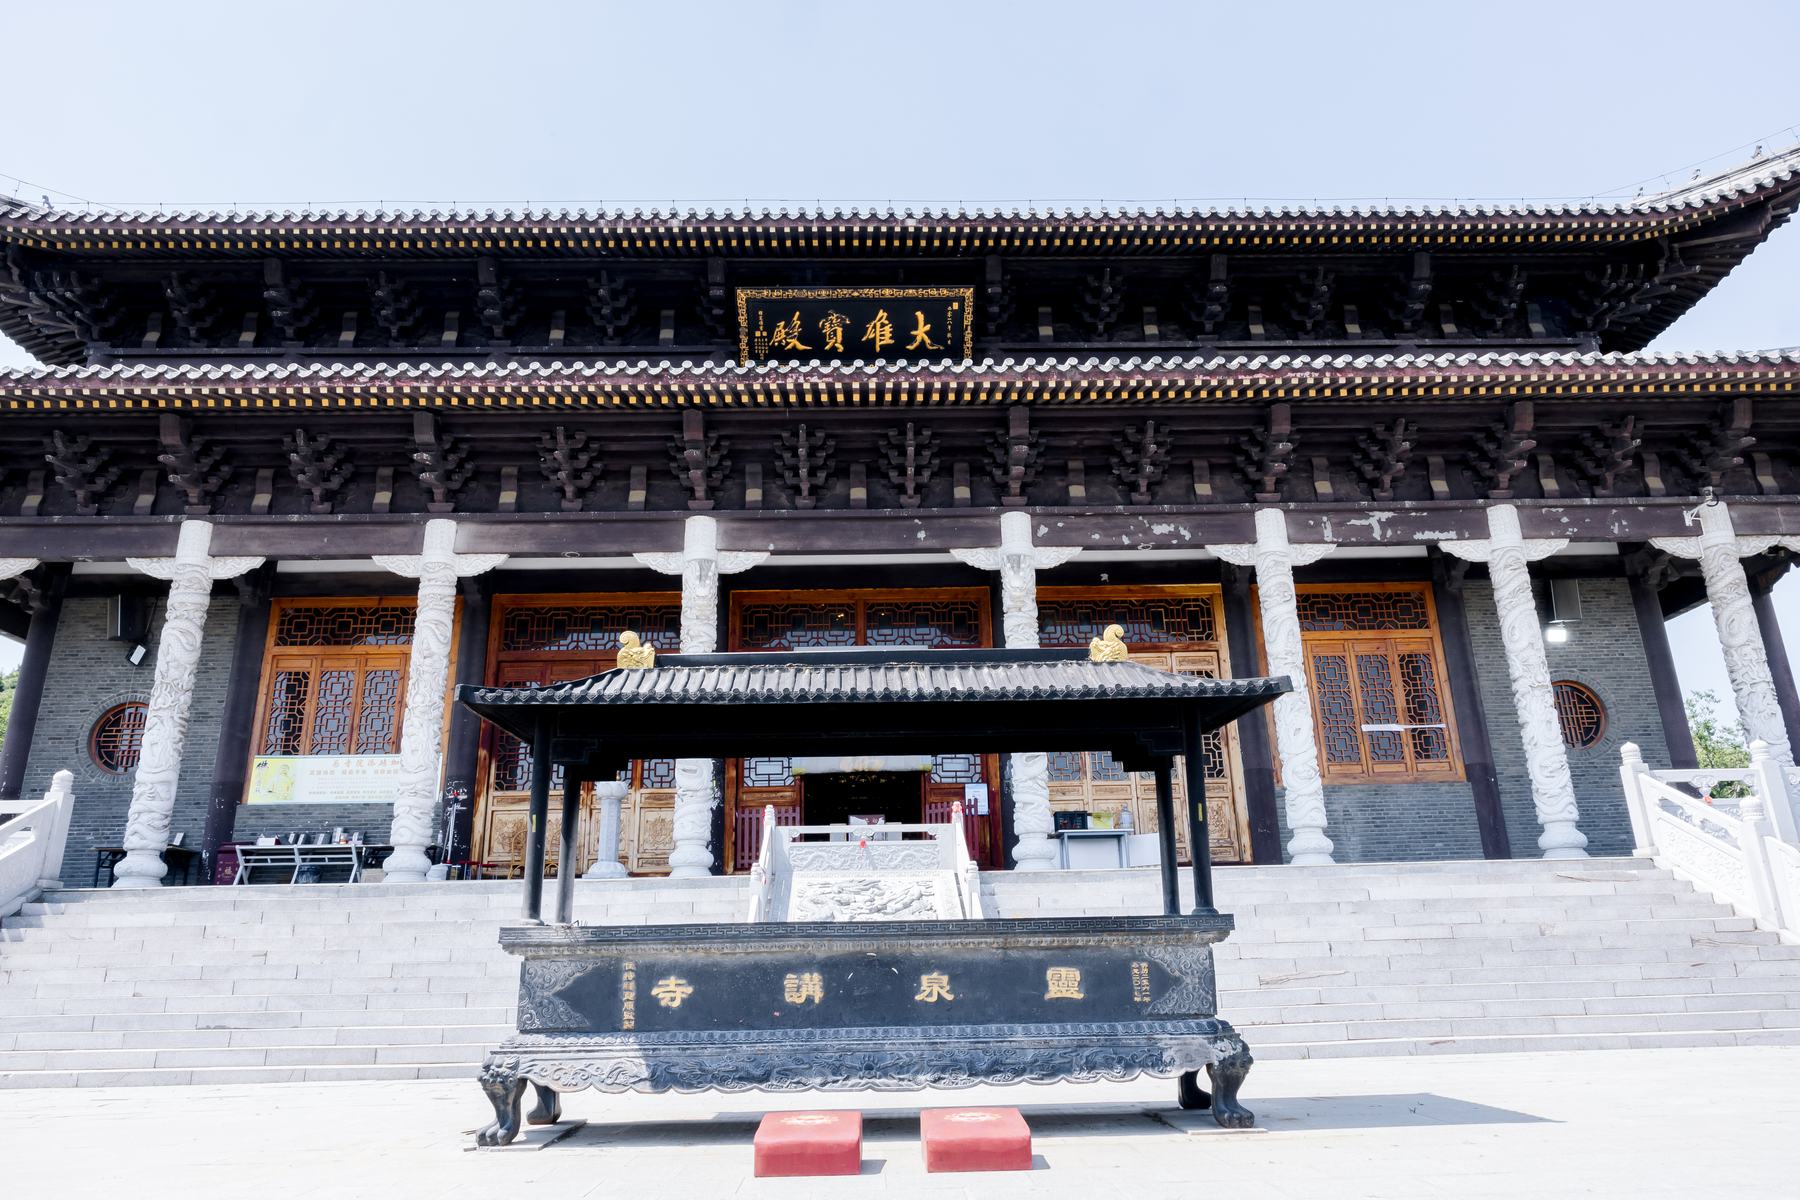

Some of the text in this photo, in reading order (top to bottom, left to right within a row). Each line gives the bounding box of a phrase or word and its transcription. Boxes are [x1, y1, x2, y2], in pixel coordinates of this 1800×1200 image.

[769, 309, 945, 353] 大雄寶殿
[650, 966, 1085, 1008] 靈泉講寺
